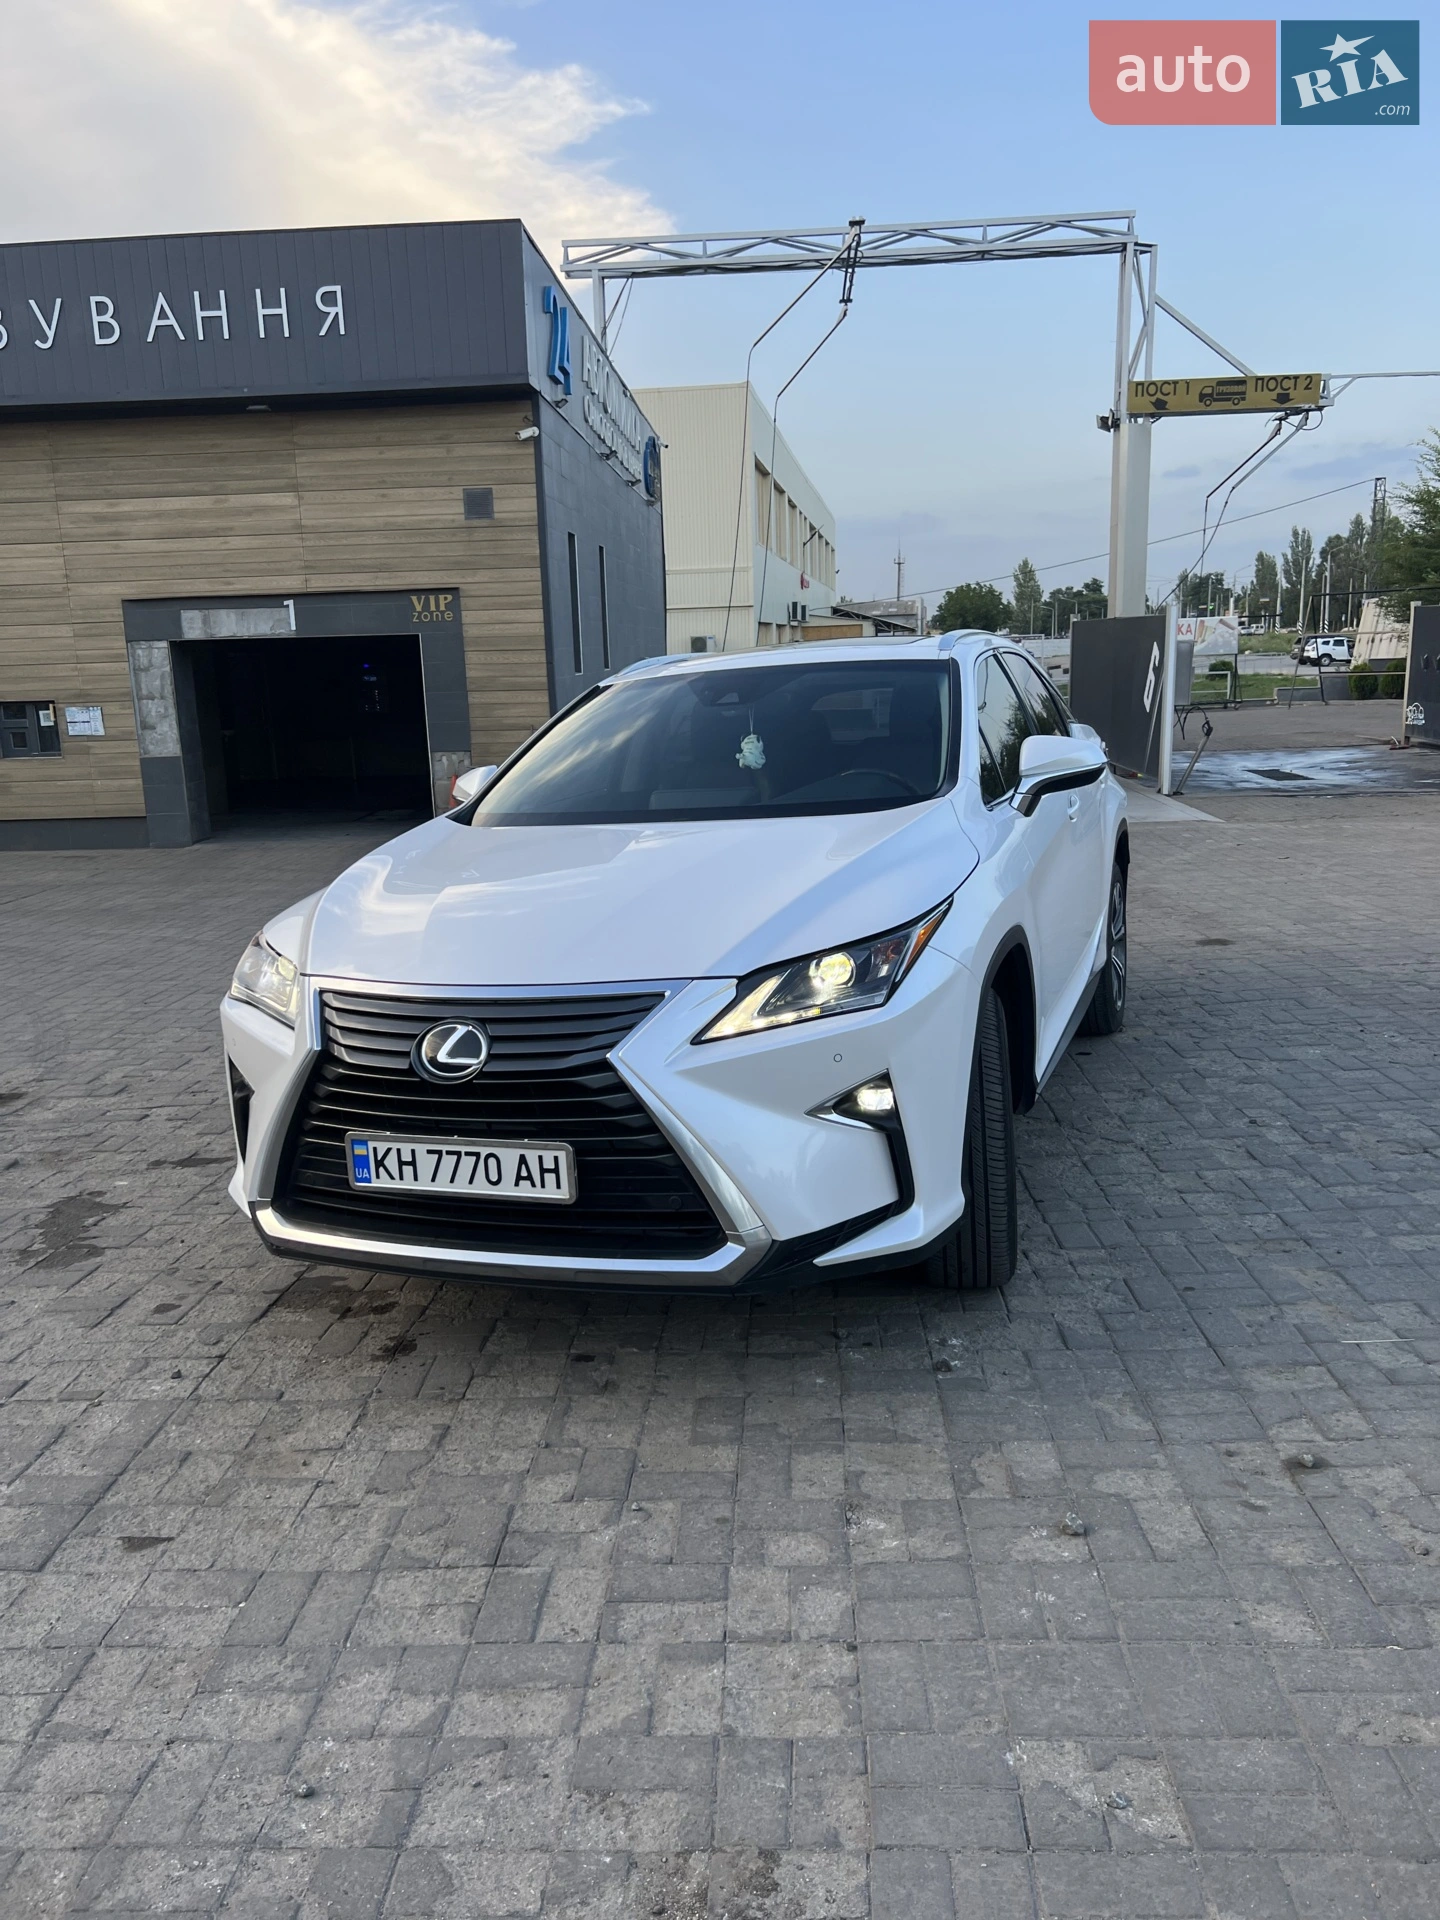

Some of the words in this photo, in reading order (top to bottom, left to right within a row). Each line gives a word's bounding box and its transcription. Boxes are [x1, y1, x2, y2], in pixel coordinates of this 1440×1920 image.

[0, 285, 345, 350] УВАННЯ
[543, 286, 572, 395] 24
[1135, 381, 1179, 397] ПОСТ
[1184, 380, 1190, 396] 1
[1254, 376, 1300, 392] ПОСТ
[1303, 376, 1313, 391] 2
[410, 594, 453, 612] VIP
[283, 599, 296, 631] 1
[412, 611, 454, 622] zone
[355, 1167, 370, 1179] UA
[372, 1146, 418, 1182] KH
[426, 1148, 503, 1187] 7770
[513, 1153, 562, 1190] AH
